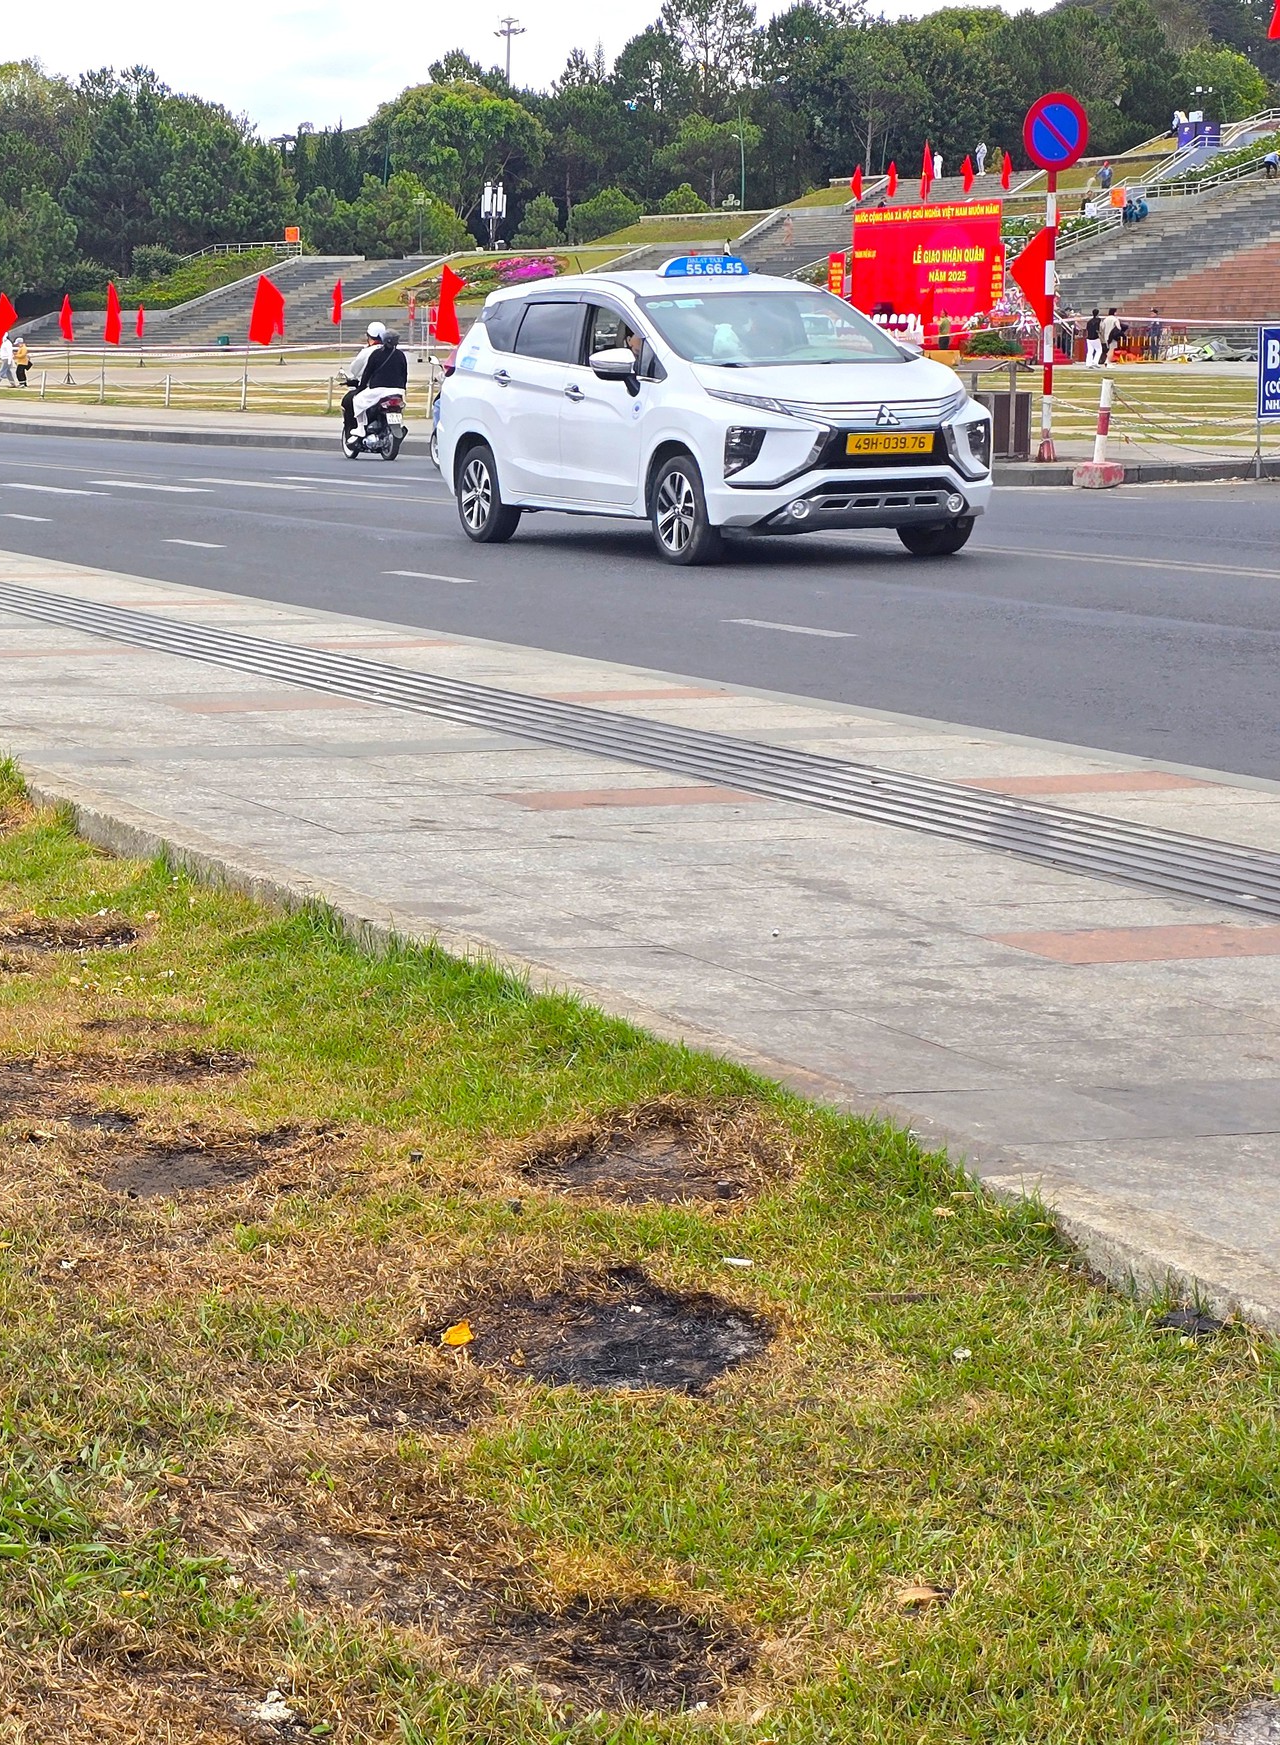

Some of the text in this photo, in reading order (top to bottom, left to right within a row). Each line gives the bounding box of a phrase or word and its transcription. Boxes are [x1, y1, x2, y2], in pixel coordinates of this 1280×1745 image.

[854, 212, 869, 223] NƯỚC
[869, 211, 883, 224] CỘNG
[941, 206, 955, 219] VIỆT
[955, 208, 968, 217] NAM
[968, 205, 985, 216] MUÔN
[913, 244, 985, 267] LỄ GIAO NHẬN QUÂN
[686, 263, 742, 274] 55.66.55
[928, 268, 967, 282] NĂM 2025
[1265, 399, 1280, 410] NH
[855, 437, 926, 450] 49H-039.76
